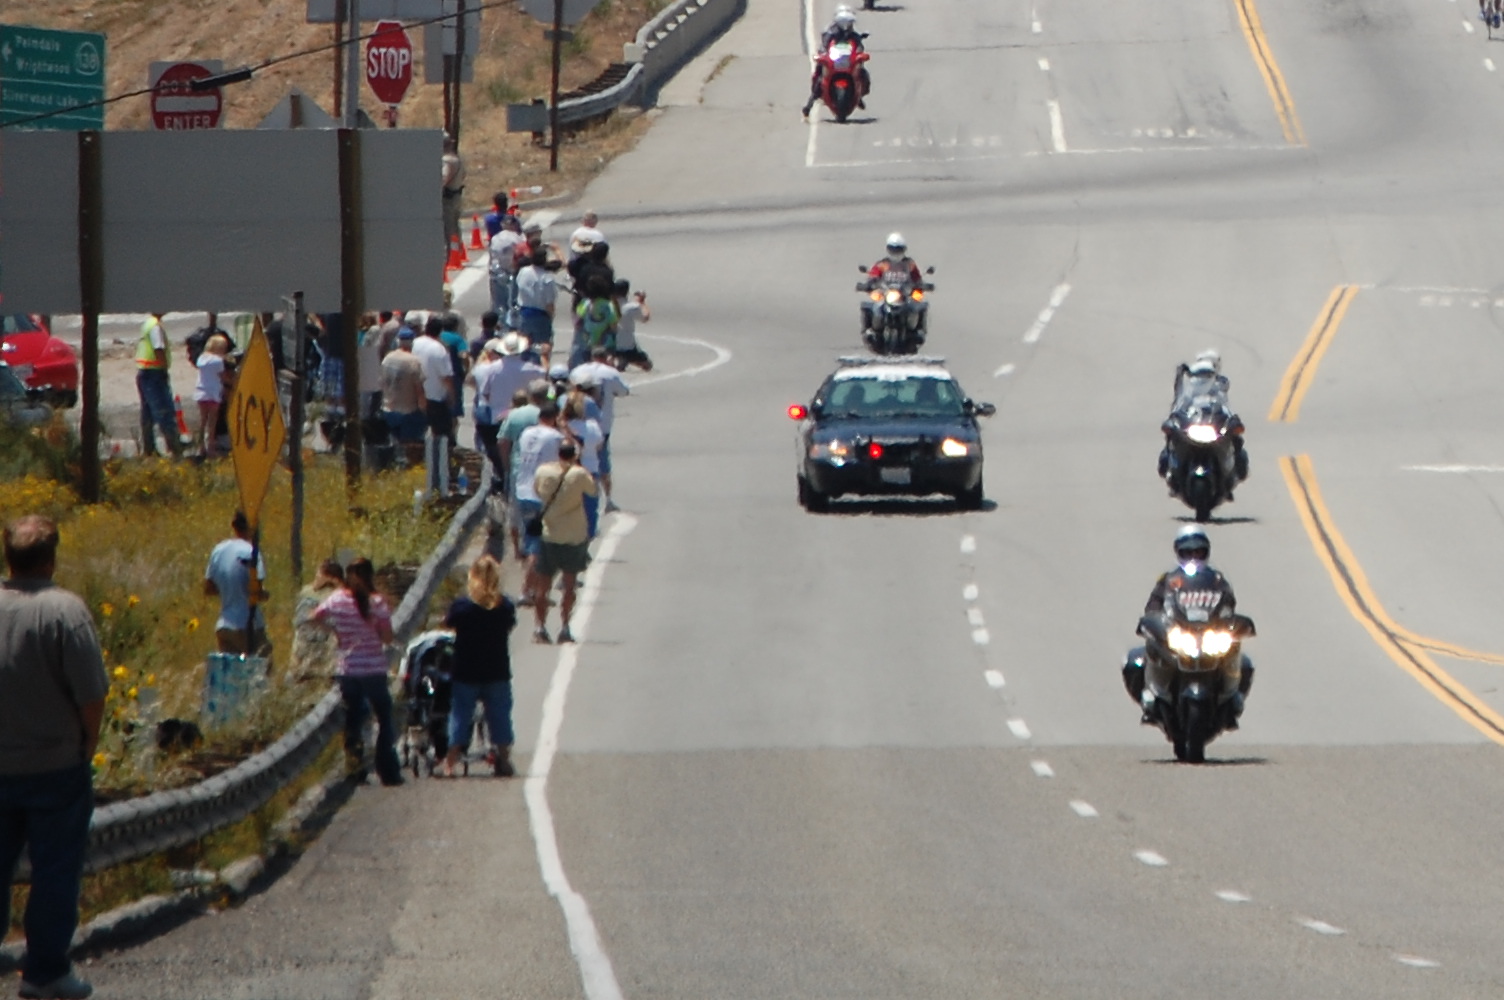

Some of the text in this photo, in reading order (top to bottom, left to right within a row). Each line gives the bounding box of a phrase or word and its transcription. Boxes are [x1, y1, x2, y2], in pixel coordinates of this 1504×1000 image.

[15, 34, 61, 52] Palmdale
[15, 56, 71, 75] Wrightwood
[78, 52, 99, 69] 138
[367, 46, 410, 79] STOP
[164, 115, 211, 131] ENTER
[236, 393, 275, 453] ICY
